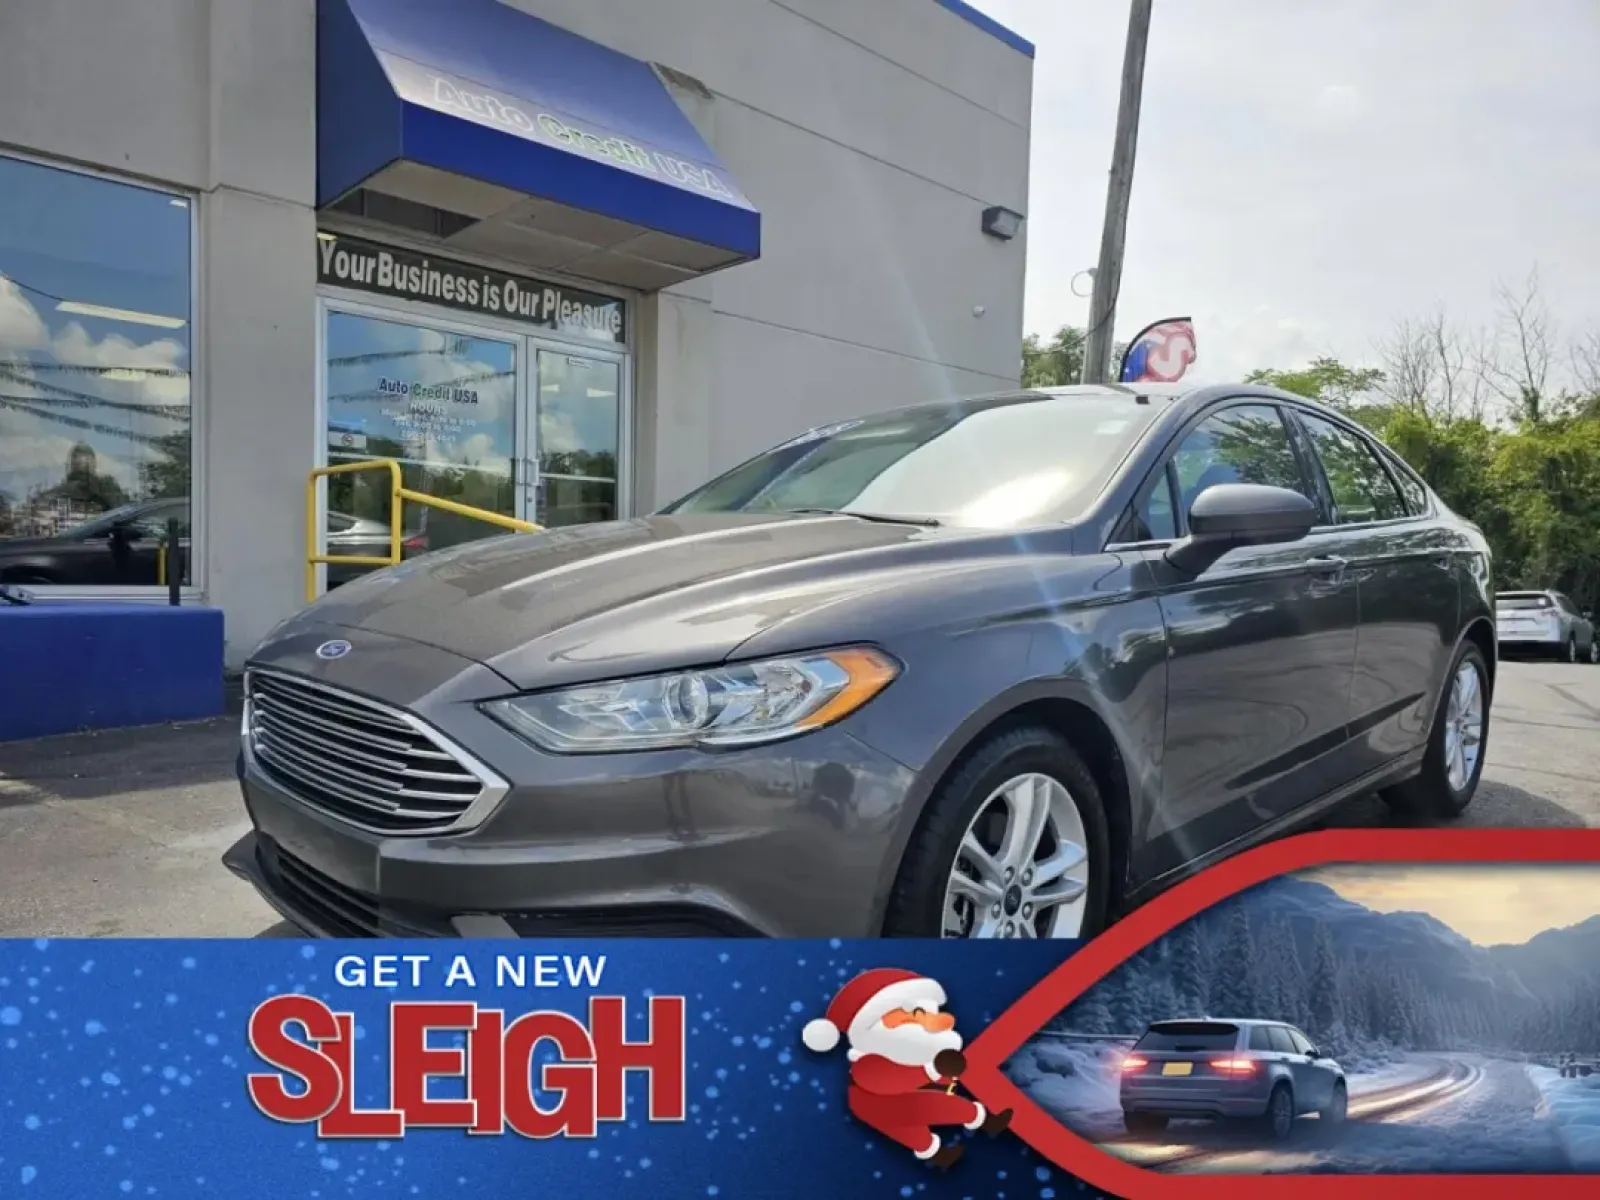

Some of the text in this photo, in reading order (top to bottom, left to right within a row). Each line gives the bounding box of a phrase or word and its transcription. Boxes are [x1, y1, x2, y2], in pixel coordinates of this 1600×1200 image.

[431, 75, 733, 198] Auto Credit USA
[319, 238, 622, 334] Your Business is Our Pleasure
[379, 377, 478, 404] Auto Credit USA
